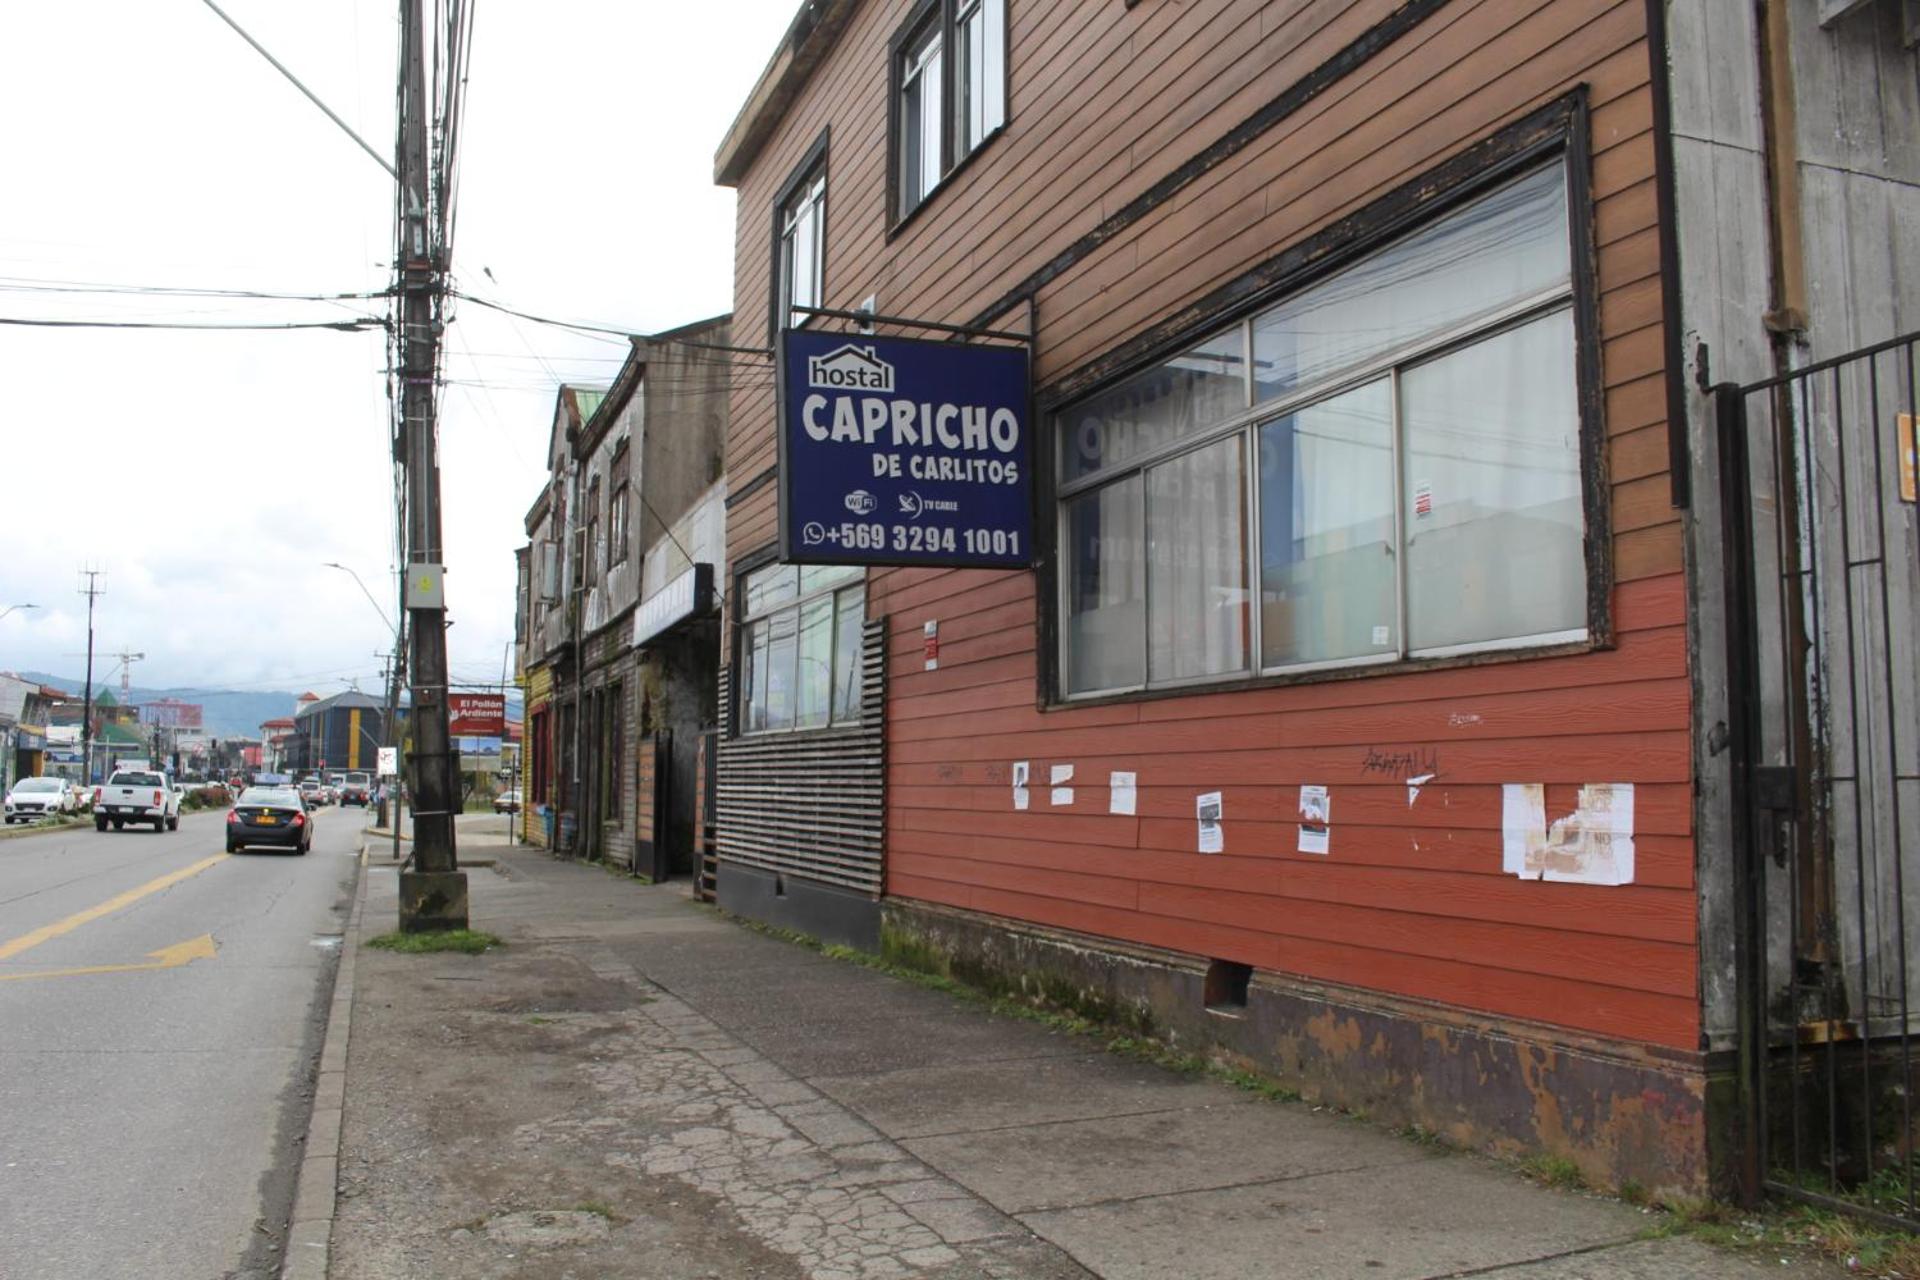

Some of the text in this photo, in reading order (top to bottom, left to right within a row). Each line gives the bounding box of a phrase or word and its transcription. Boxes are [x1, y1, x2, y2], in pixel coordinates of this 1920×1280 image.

[812, 360, 890, 389] hostal
[802, 394, 1019, 453] CAPRICHO
[873, 453, 1019, 485] DE CARLITOS
[936, 500, 958, 512] CABLE
[827, 523, 1020, 556] +569 3294 1001
[459, 709, 502, 717] Ardiente
